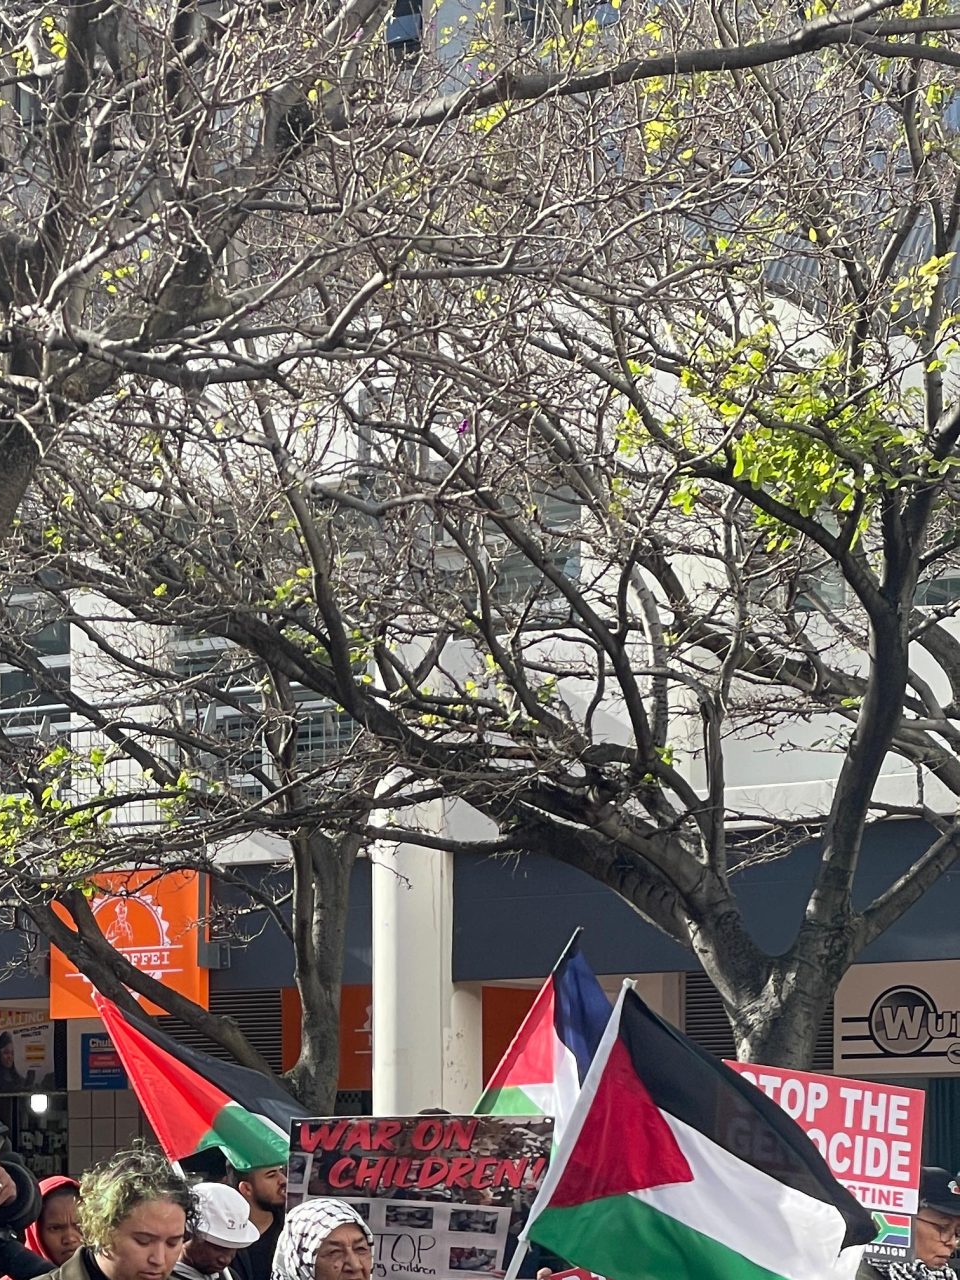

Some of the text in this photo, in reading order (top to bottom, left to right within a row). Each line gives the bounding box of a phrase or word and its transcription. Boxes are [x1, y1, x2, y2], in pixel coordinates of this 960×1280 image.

[840, 1087, 910, 1136] THE
[300, 1119, 479, 1153] WAR ON
[328, 1157, 546, 1191] CHILDREN!
[373, 1233, 437, 1264] TOP
[865, 1244, 907, 1258] MPAIGN
